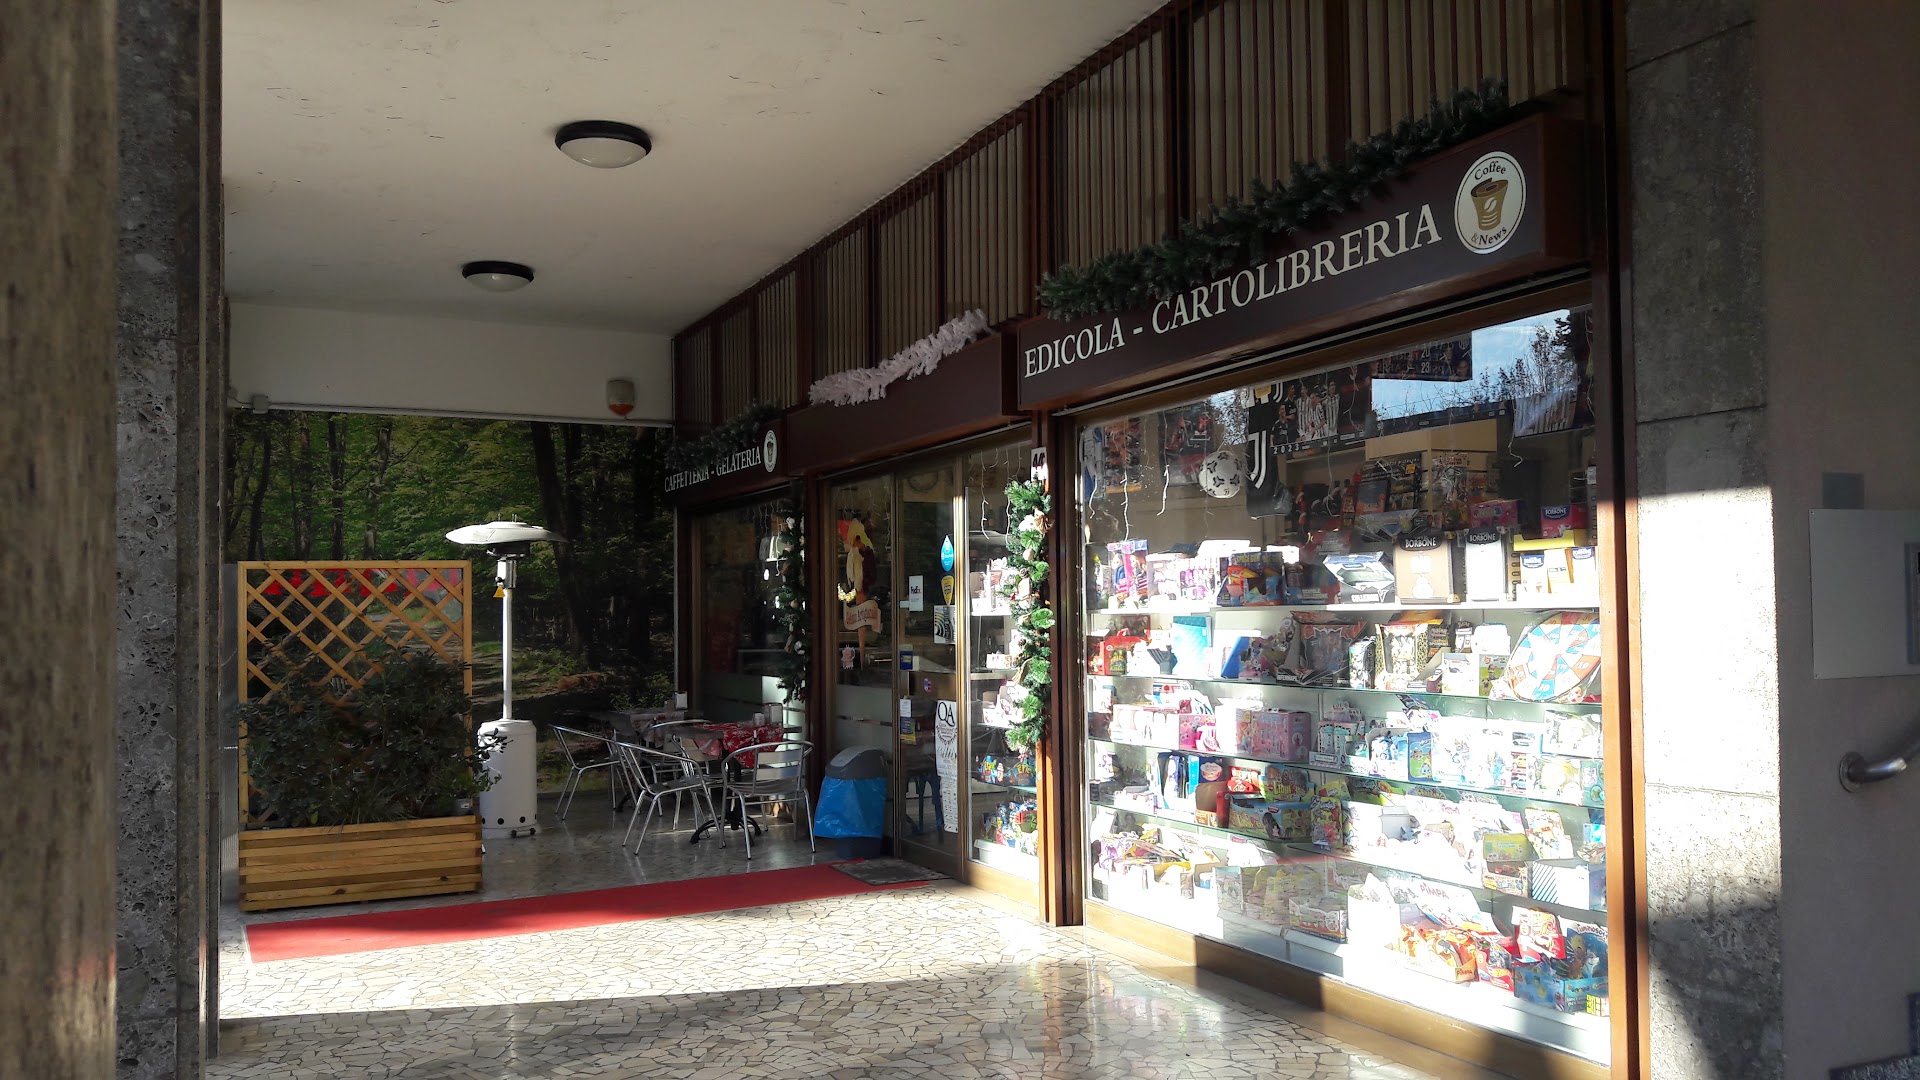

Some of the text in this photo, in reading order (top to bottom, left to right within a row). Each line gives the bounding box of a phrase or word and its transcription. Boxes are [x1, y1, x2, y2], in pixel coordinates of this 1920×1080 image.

[1474, 160, 1507, 181] Coffee
[1024, 317, 1125, 378] EDICOLA
[1151, 203, 1443, 336] CARTOLIBRERIA
[716, 446, 762, 477] GELATERIA
[1404, 536, 1437, 549] BORBONE
[1469, 533, 1496, 542] BORBONE
[1419, 881, 1450, 899] PIMPA
